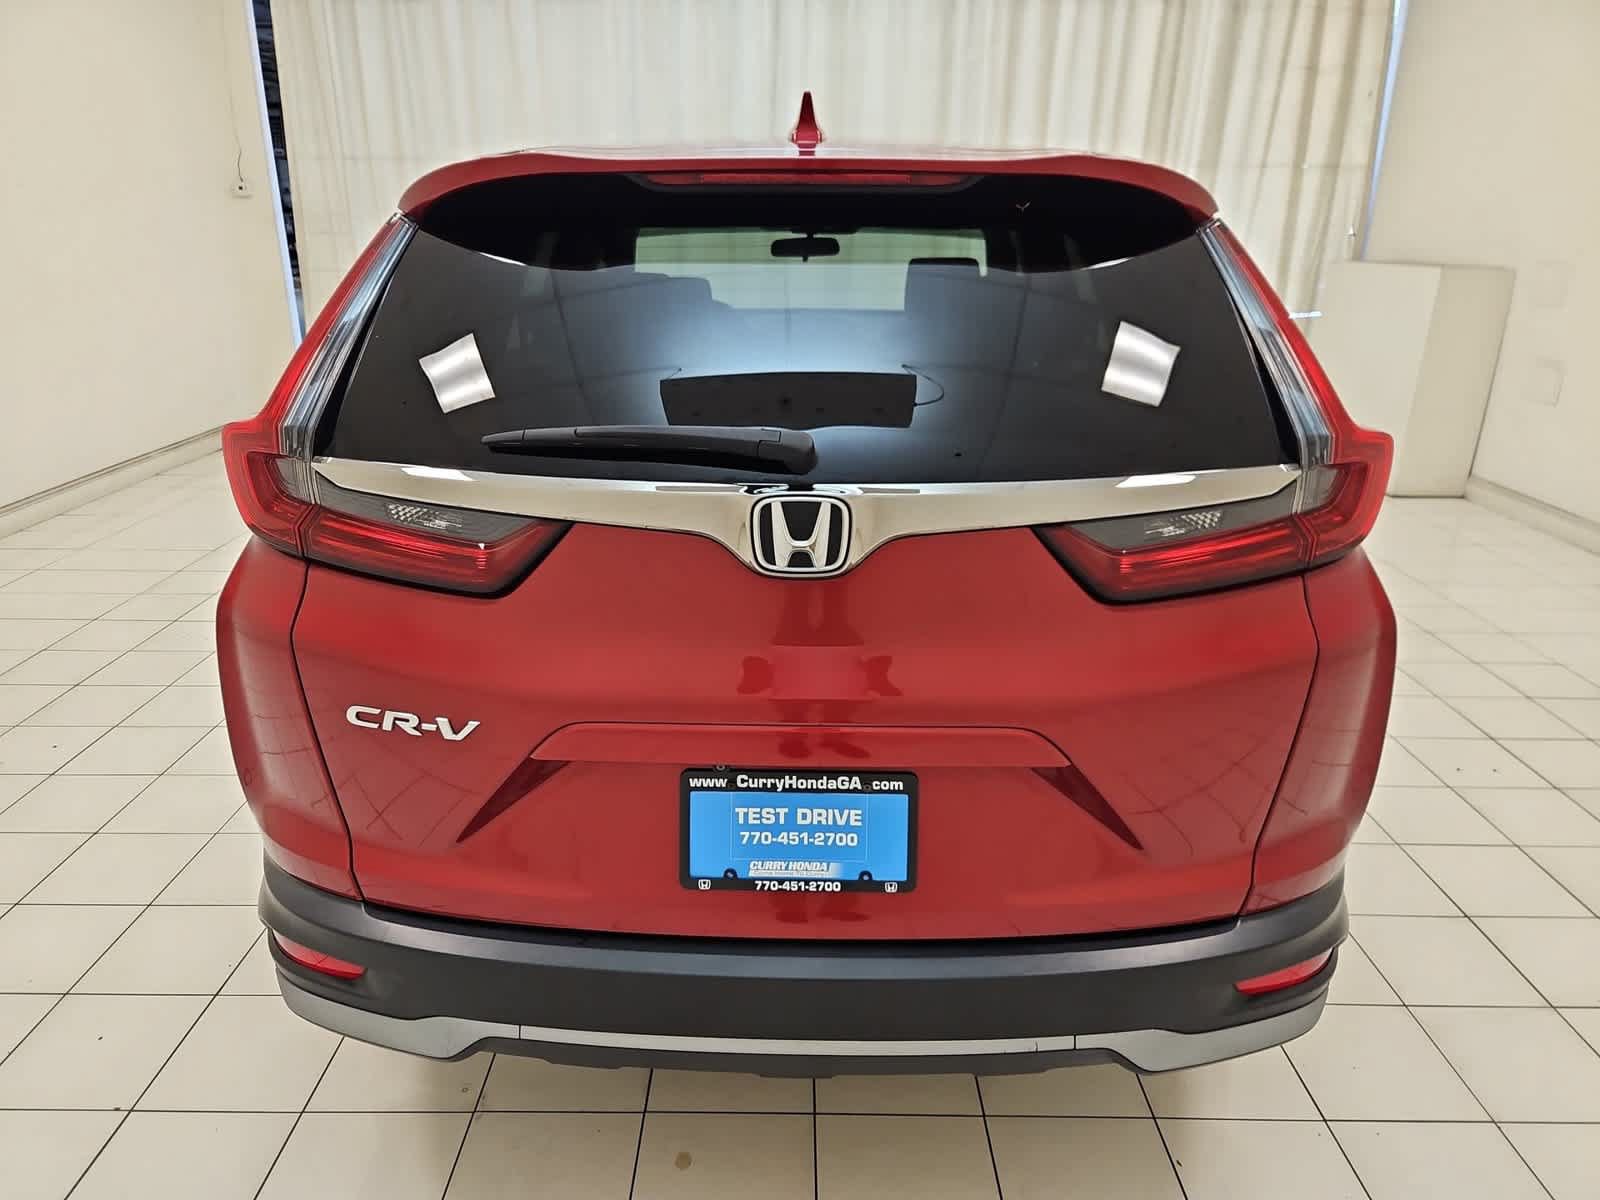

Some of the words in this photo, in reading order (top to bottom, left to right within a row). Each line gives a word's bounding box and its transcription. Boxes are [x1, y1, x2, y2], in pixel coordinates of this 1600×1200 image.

[346, 705, 481, 741] CR-V
[689, 777, 727, 788] www
[736, 774, 862, 792] CurryHondaGA
[735, 807, 789, 825] TEST
[796, 808, 863, 826] DRIVE
[740, 831, 858, 847] 770-451-2700
[749, 860, 789, 871] CURRY
[788, 861, 828, 872] HONDA
[754, 880, 841, 892] 770-451-2700
